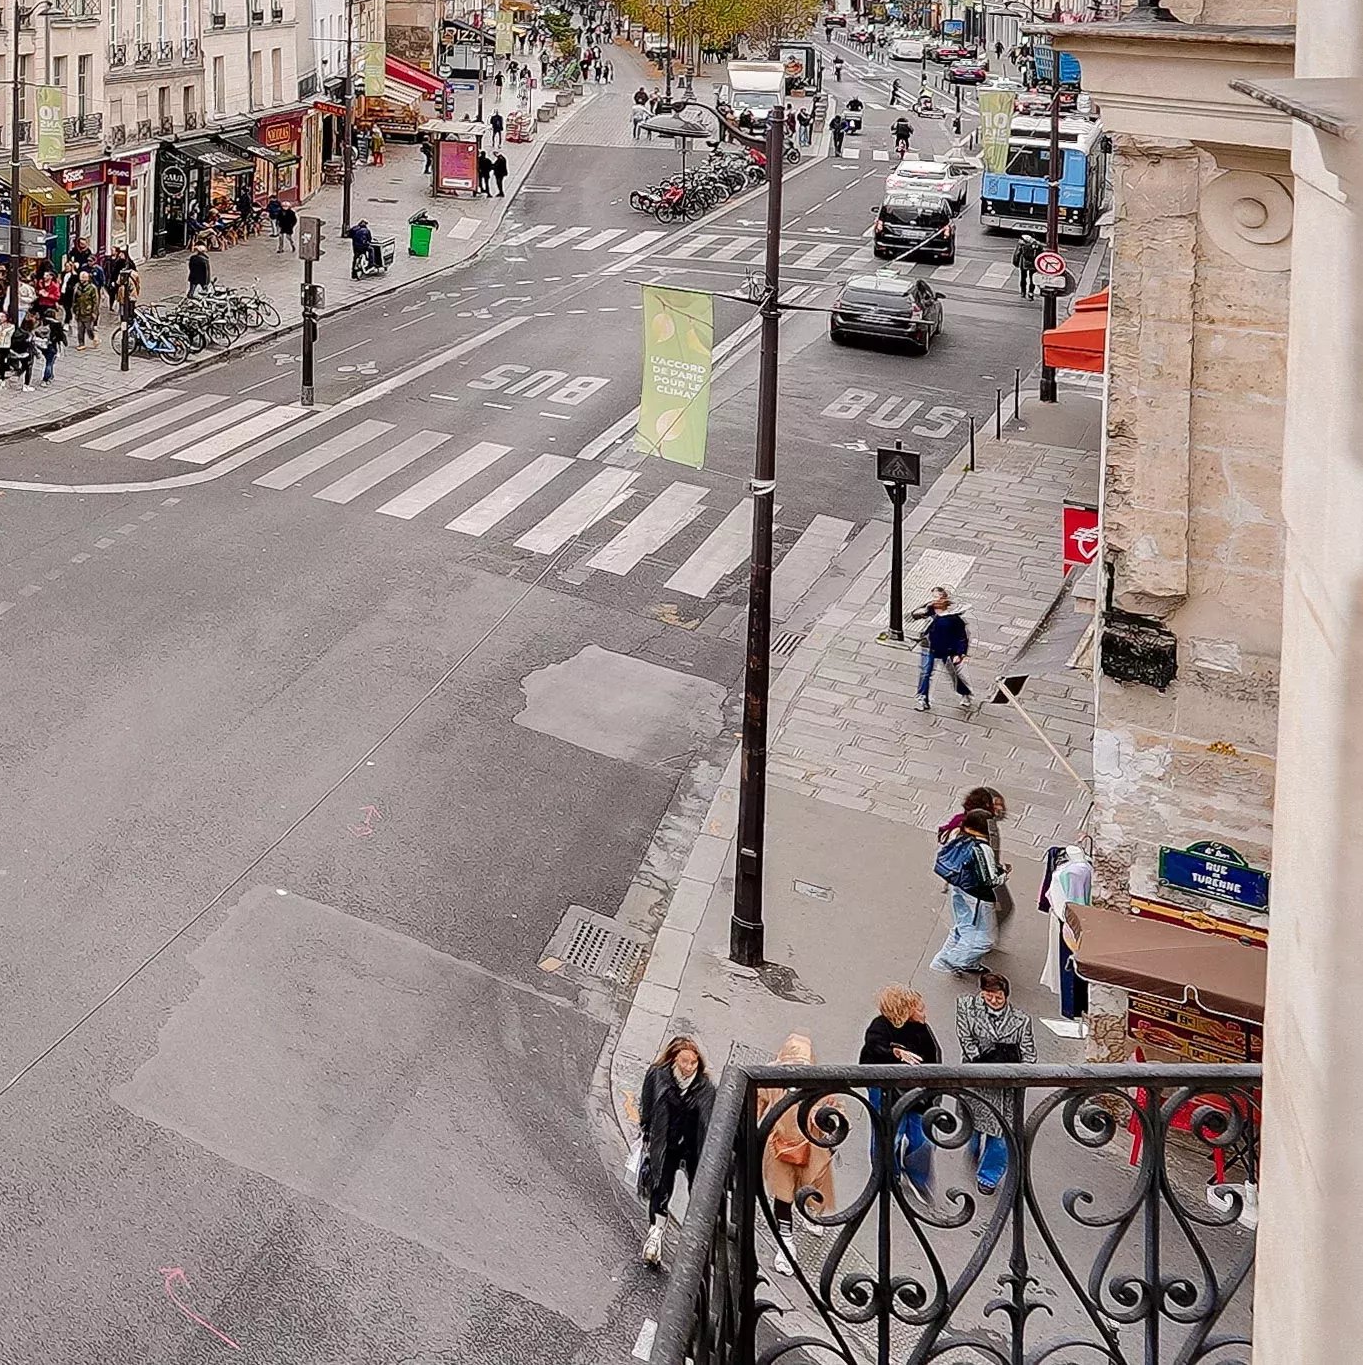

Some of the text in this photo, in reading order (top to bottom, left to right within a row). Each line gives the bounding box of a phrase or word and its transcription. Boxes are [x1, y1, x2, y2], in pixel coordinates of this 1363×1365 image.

[982, 112, 1008, 128] 10
[650, 355, 707, 374] L'ACCORD
[653, 365, 704, 383] DE PARIS
[467, 363, 612, 407] BUS
[653, 375, 702, 392] POUR LE
[656, 384, 698, 400] CLIMAT
[819, 386, 968, 439] BUS
[1205, 861, 1229, 876] RUE
[1192, 872, 1242, 894] TURENNE
